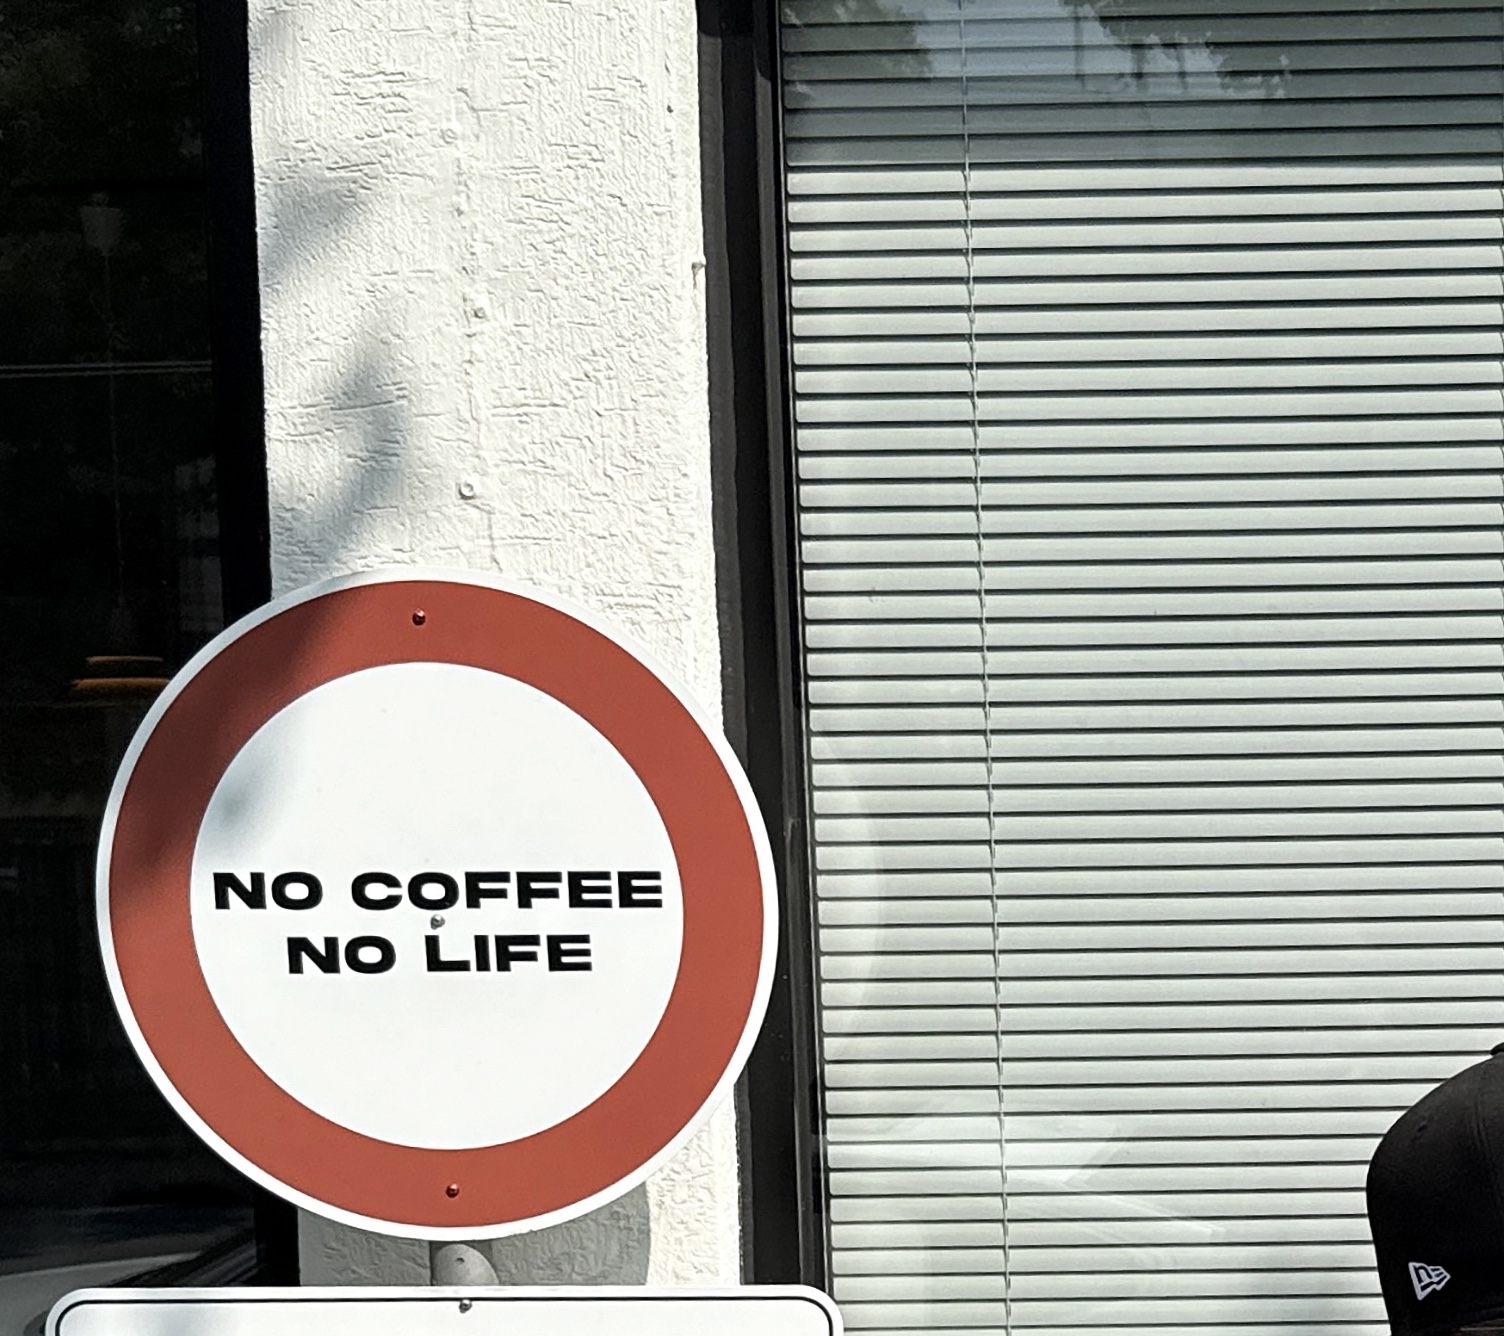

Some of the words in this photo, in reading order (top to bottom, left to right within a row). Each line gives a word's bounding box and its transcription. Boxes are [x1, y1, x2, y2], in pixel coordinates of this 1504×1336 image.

[213, 871, 323, 911] NO
[351, 871, 663, 911] COFFEE
[287, 935, 396, 974] NO
[424, 934, 592, 972] LIFE
